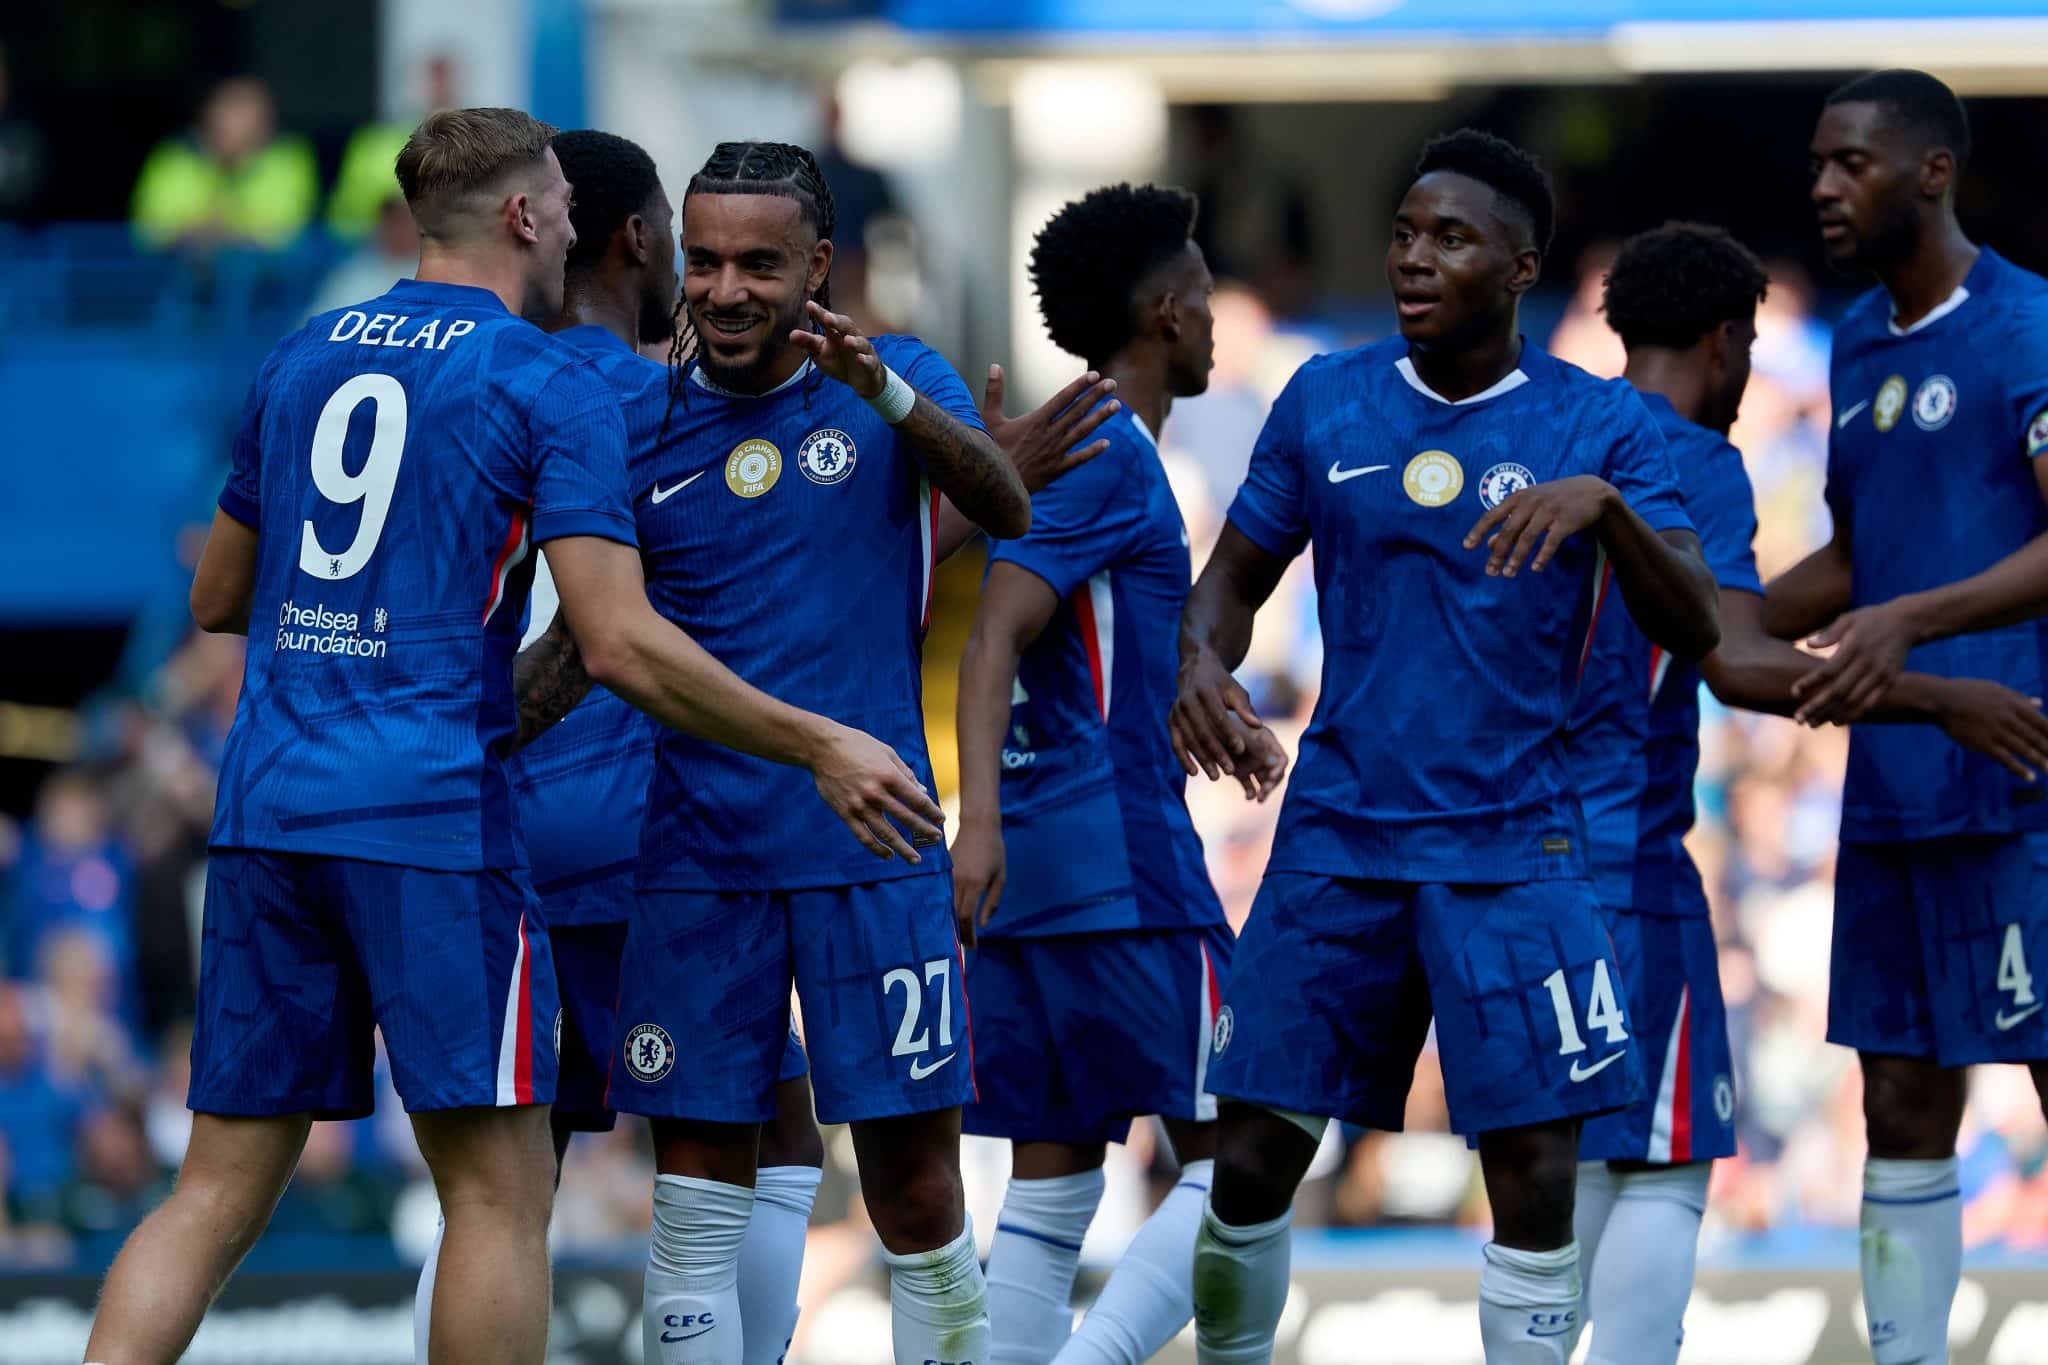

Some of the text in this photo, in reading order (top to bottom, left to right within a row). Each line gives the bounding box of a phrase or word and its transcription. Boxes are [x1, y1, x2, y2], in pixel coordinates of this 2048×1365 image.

[328, 310, 476, 351] DELAP
[807, 430, 845, 446] CHELSEA
[299, 373, 408, 580] 9
[743, 482, 765, 494] FIFA
[279, 600, 359, 632] Chelsea
[275, 627, 387, 658] Foundation
[1997, 923, 2036, 1005] 4
[882, 958, 954, 1057] 27
[1543, 958, 1629, 1056] 14
[632, 1025, 666, 1041] CHELSEA
[663, 1312, 715, 1328] CFC
[1531, 1311, 1575, 1326] CFC
